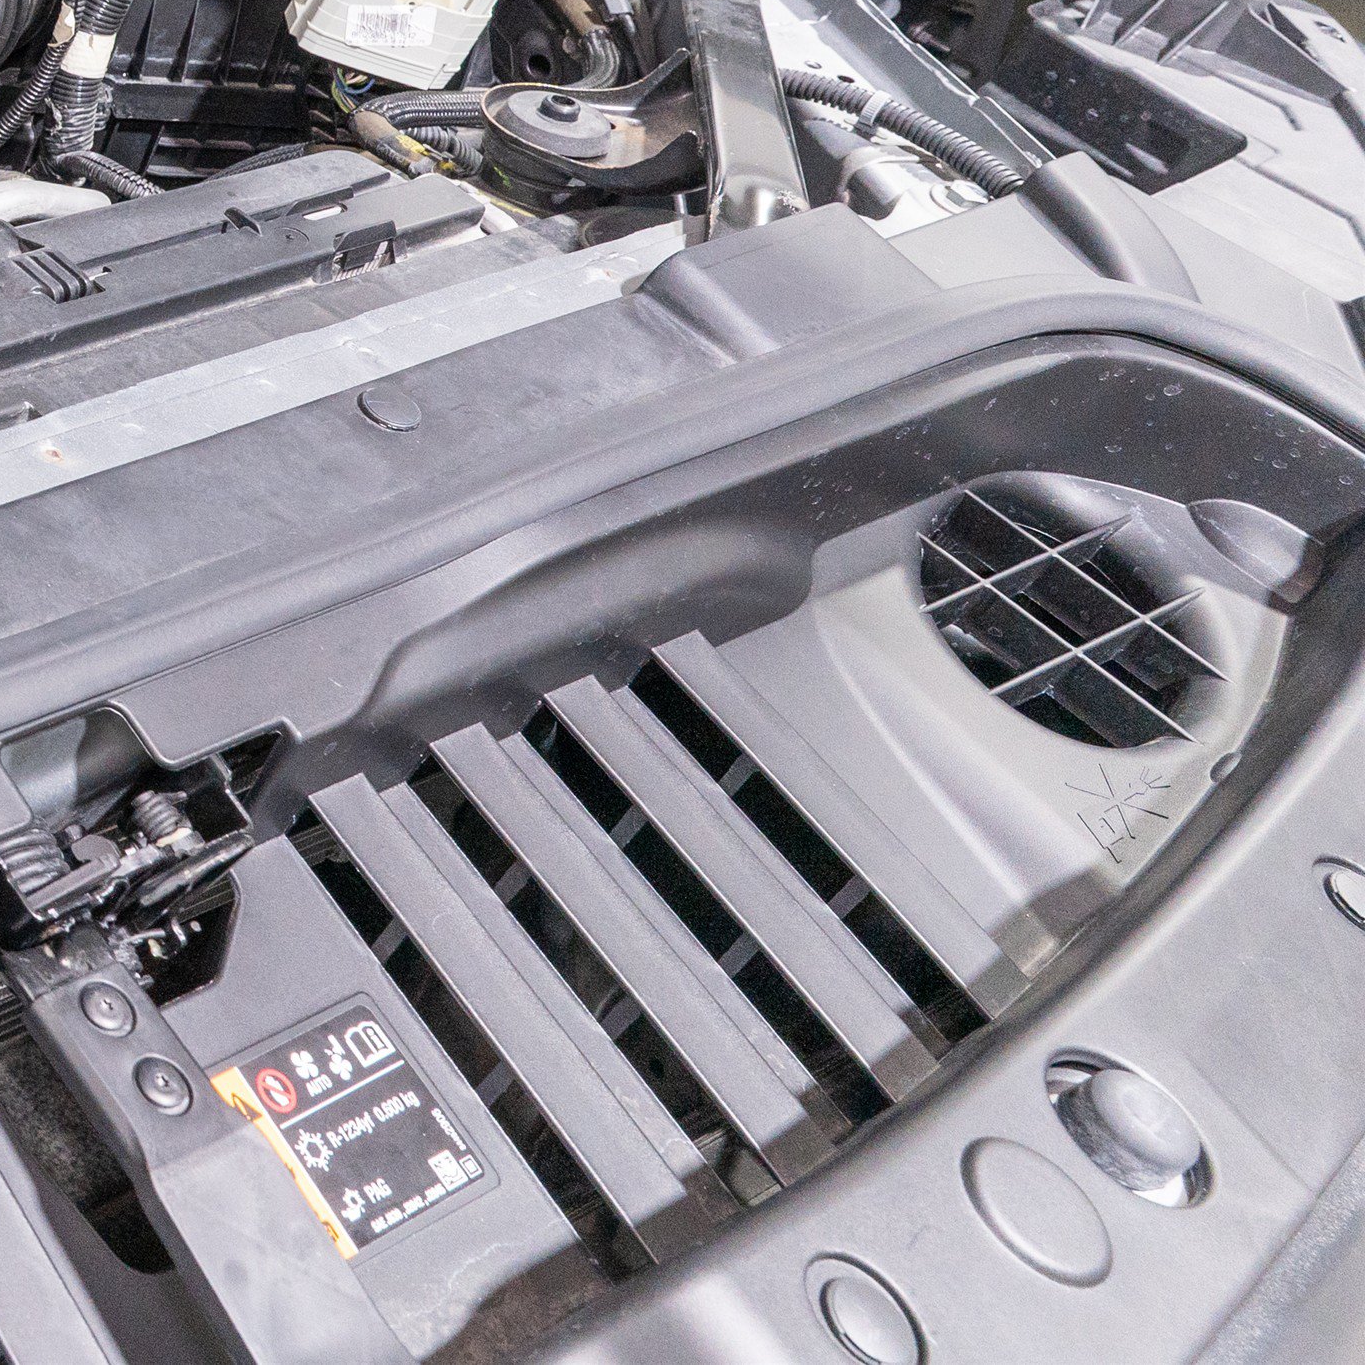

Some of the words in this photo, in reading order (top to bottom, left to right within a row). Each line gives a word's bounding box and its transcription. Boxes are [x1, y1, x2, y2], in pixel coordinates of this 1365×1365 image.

[306, 1074, 333, 1097] AUTO
[326, 1111, 375, 1148] R-1234yf
[399, 1091, 421, 1108] kg
[363, 1178, 393, 1204] PAG
